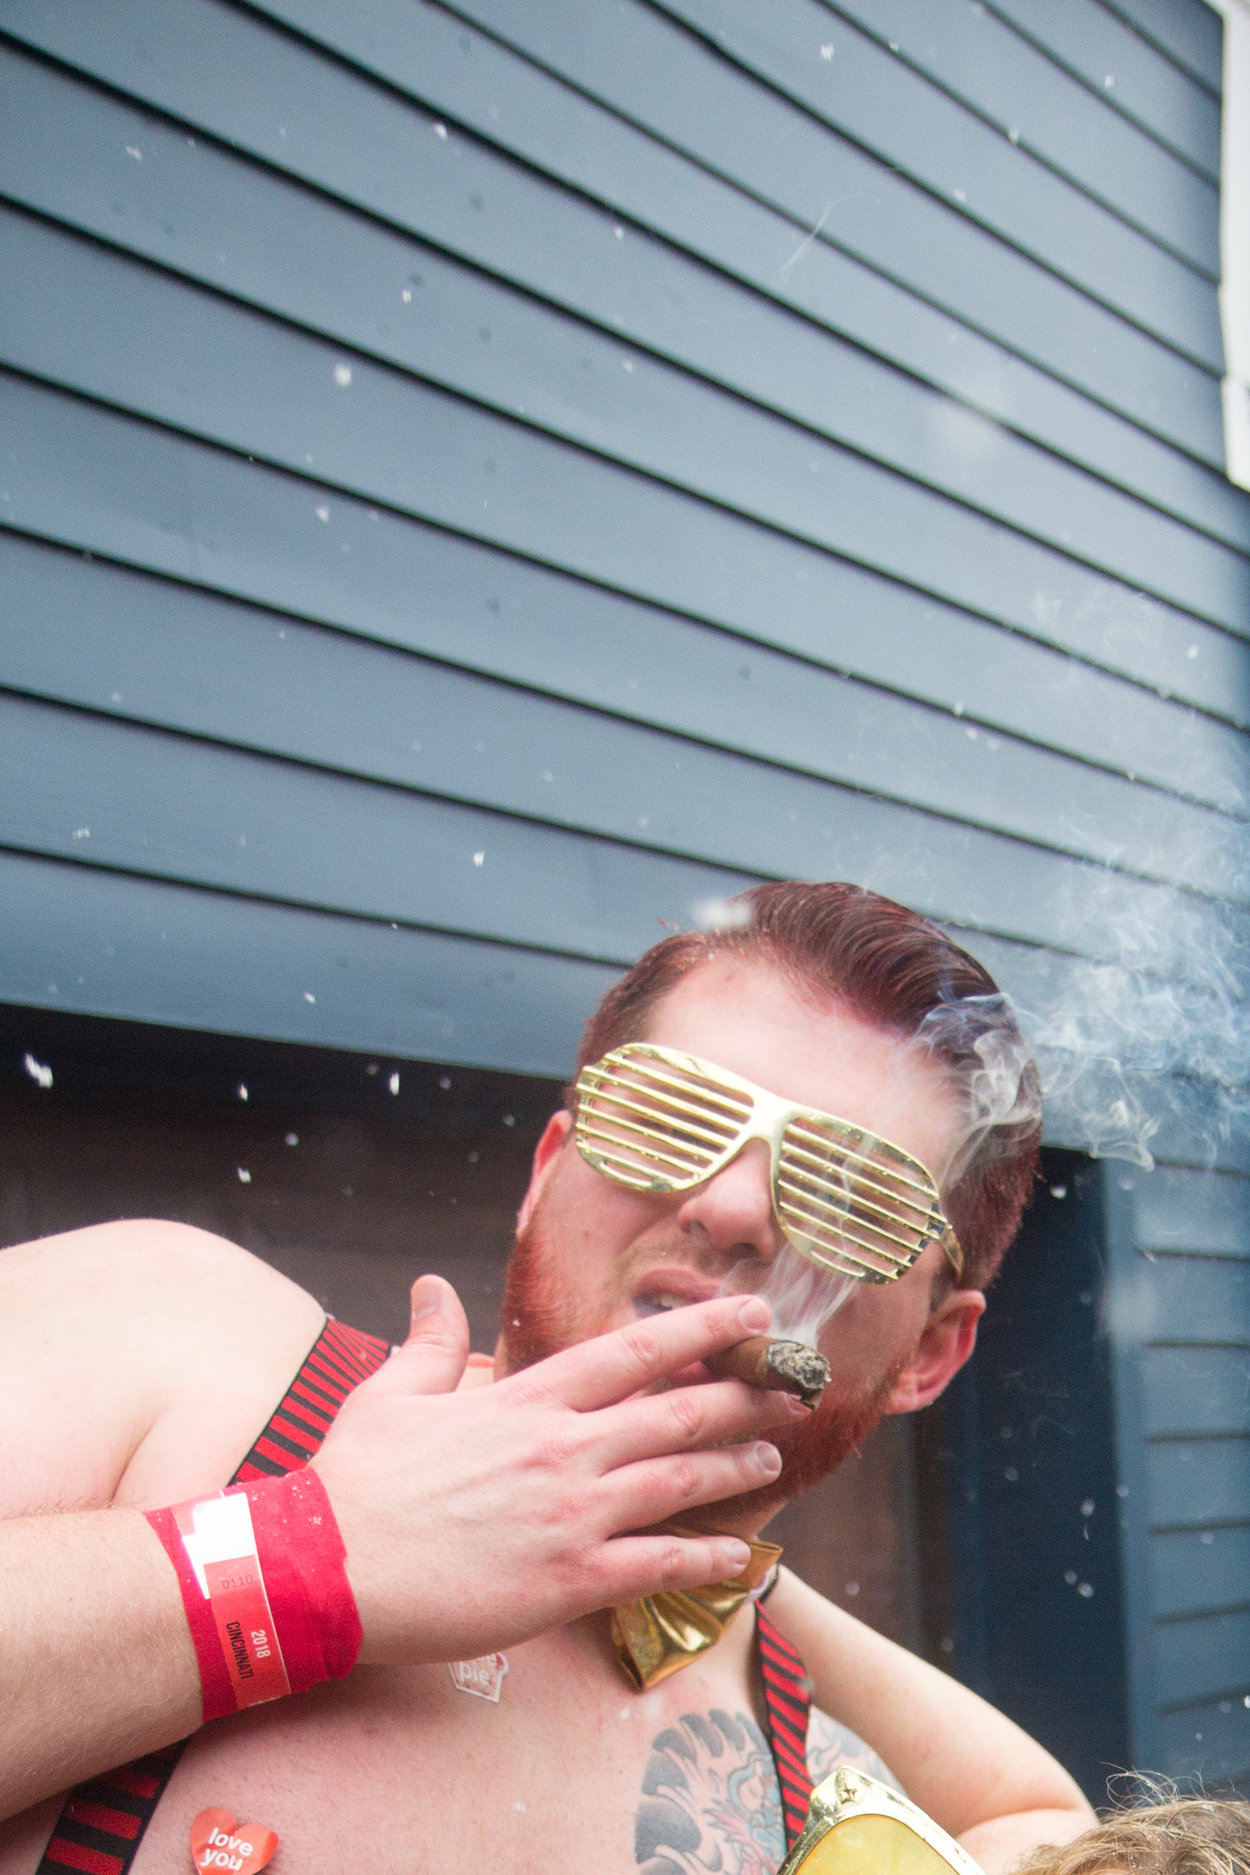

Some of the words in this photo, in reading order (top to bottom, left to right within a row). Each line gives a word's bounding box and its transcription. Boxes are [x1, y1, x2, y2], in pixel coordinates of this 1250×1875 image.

[226, 1621, 254, 1680] CINCINNATI
[250, 1629, 271, 1659] 2018
[207, 1827, 254, 1857] love
[200, 1848, 245, 1871] you
